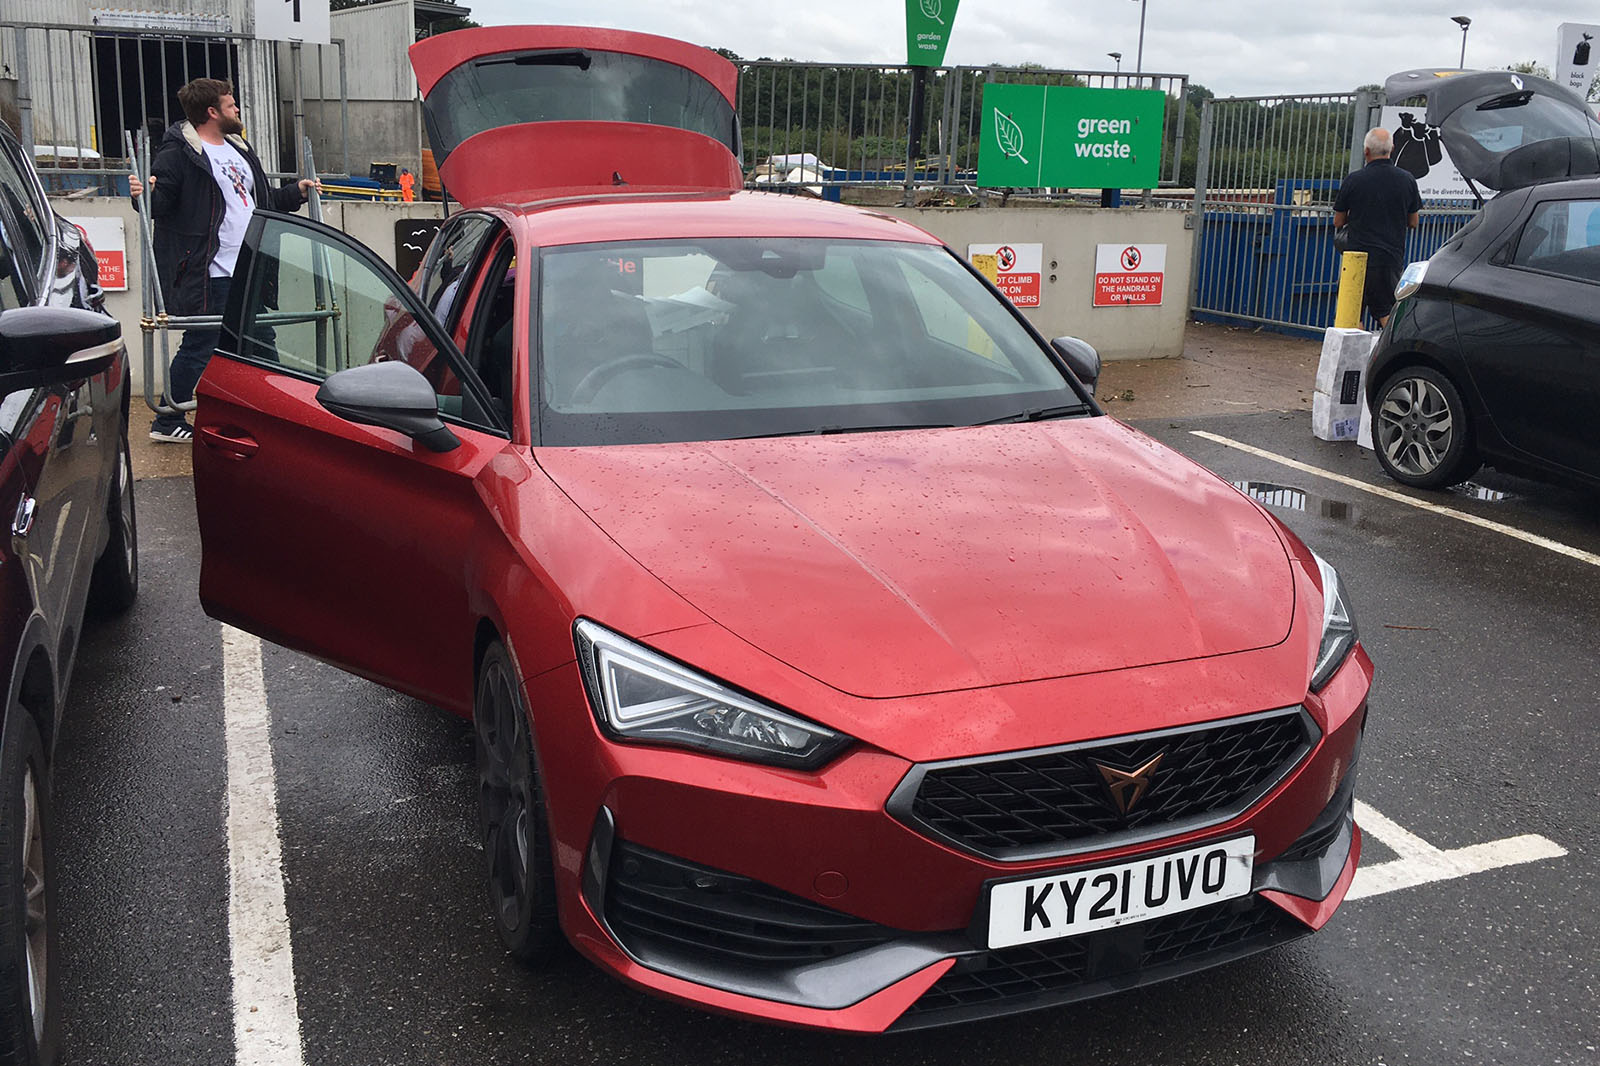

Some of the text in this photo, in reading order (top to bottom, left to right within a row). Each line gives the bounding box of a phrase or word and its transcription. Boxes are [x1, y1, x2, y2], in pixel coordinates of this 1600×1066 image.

[917, 32, 941, 41] garden
[1077, 118, 1131, 138] green
[1074, 140, 1131, 158] waste
[104, 265, 120, 273] THE
[997, 276, 1033, 284] OT CLIMB
[1110, 276, 1125, 284] NOT
[1126, 276, 1149, 284] STAND
[1009, 286, 1022, 294] ON
[1007, 295, 1038, 304] AINERS
[1023, 848, 1227, 932] KY21 UVO
